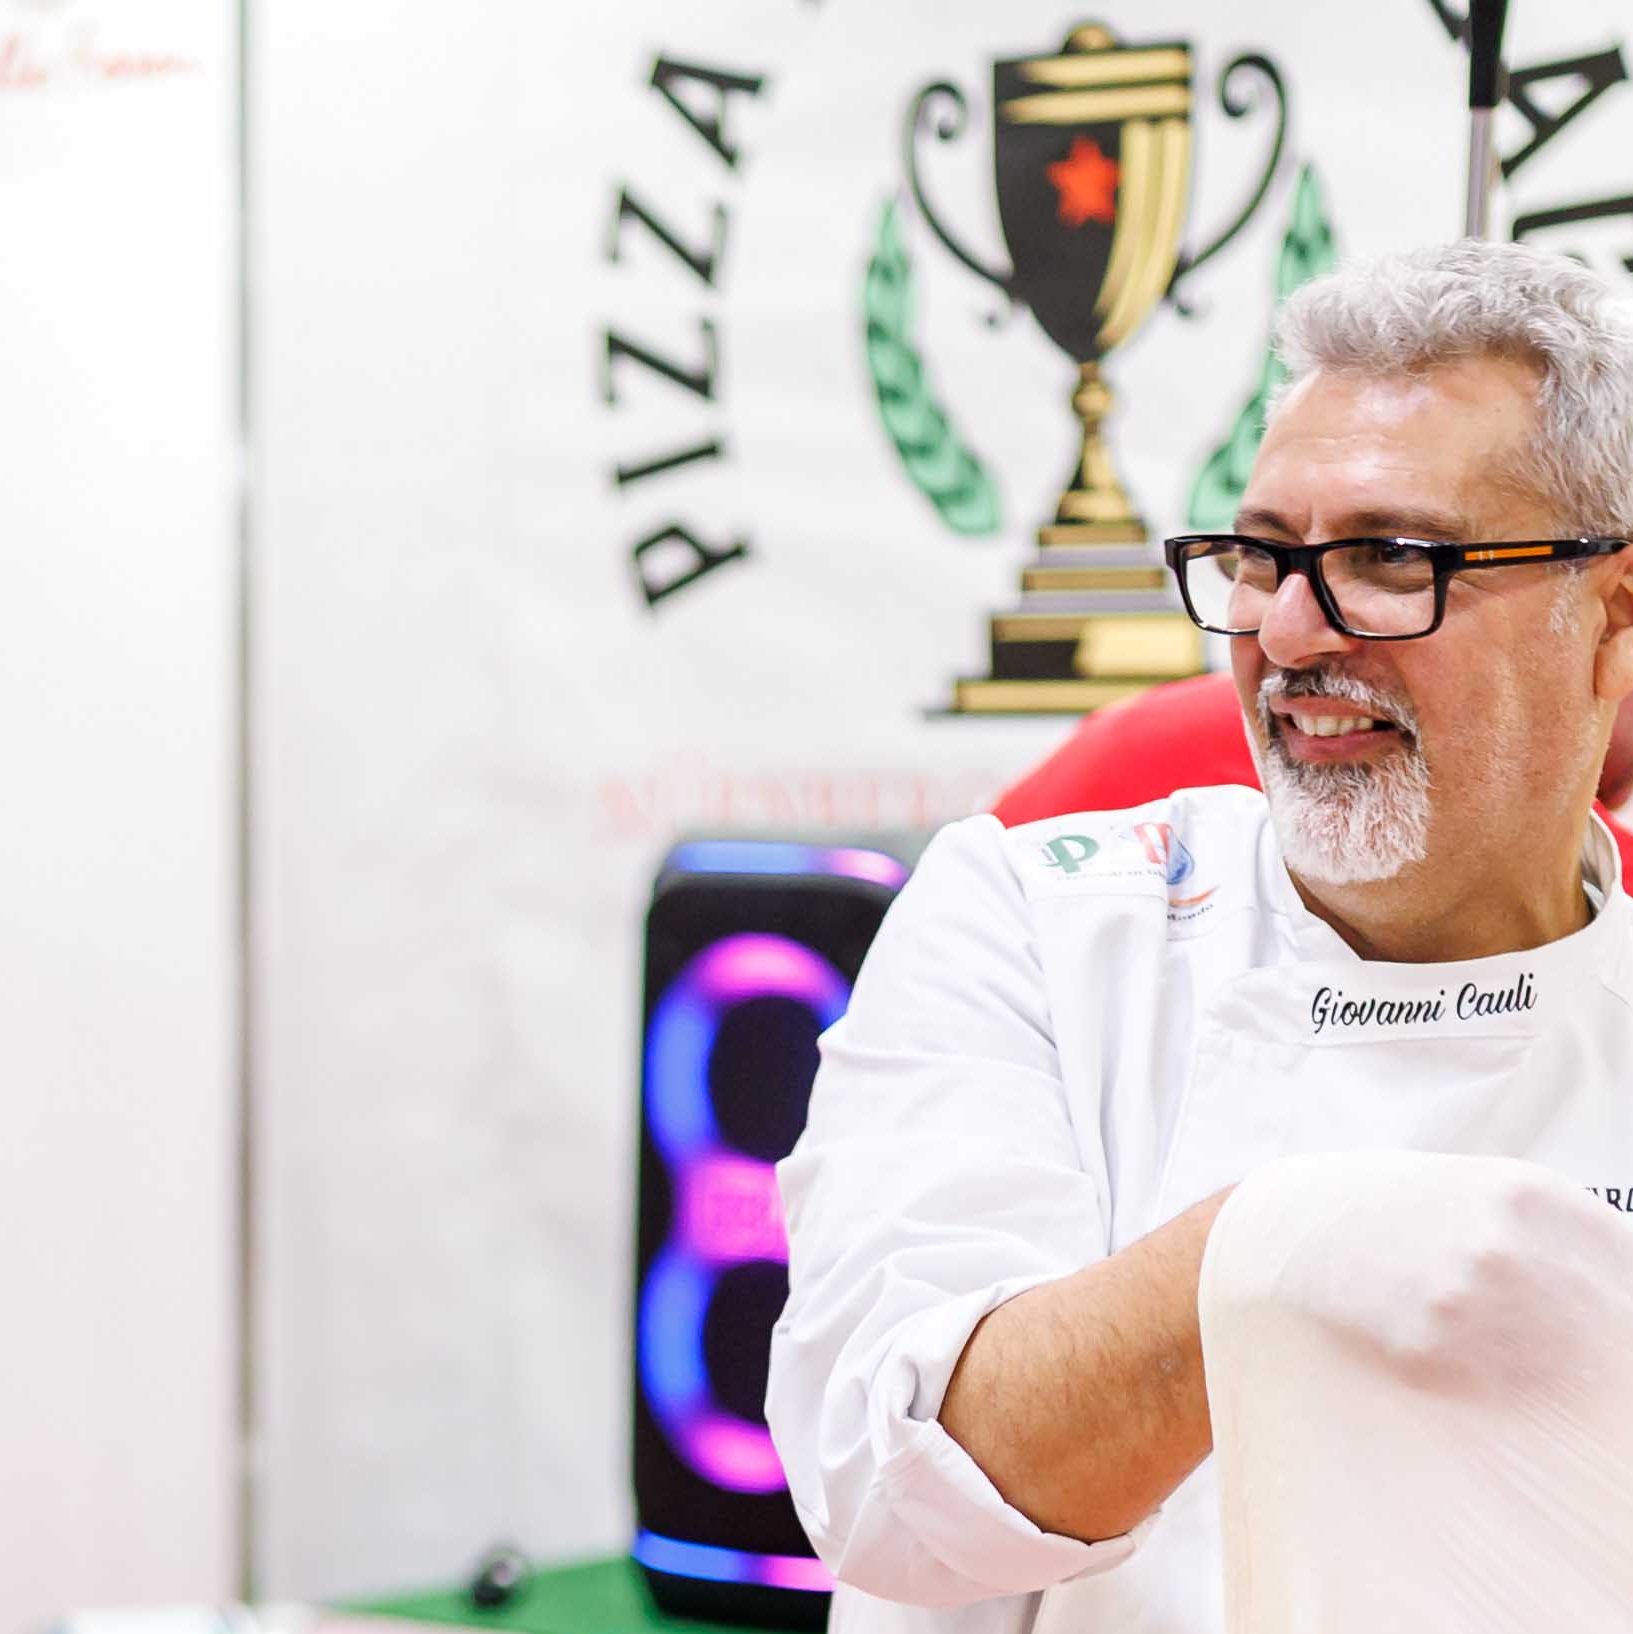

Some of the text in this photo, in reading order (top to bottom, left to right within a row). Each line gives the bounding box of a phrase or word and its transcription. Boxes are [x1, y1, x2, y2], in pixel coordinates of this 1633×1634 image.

[602, 56, 764, 606] PIZZA
[1311, 972, 1538, 1034] Giovanni Cauli
